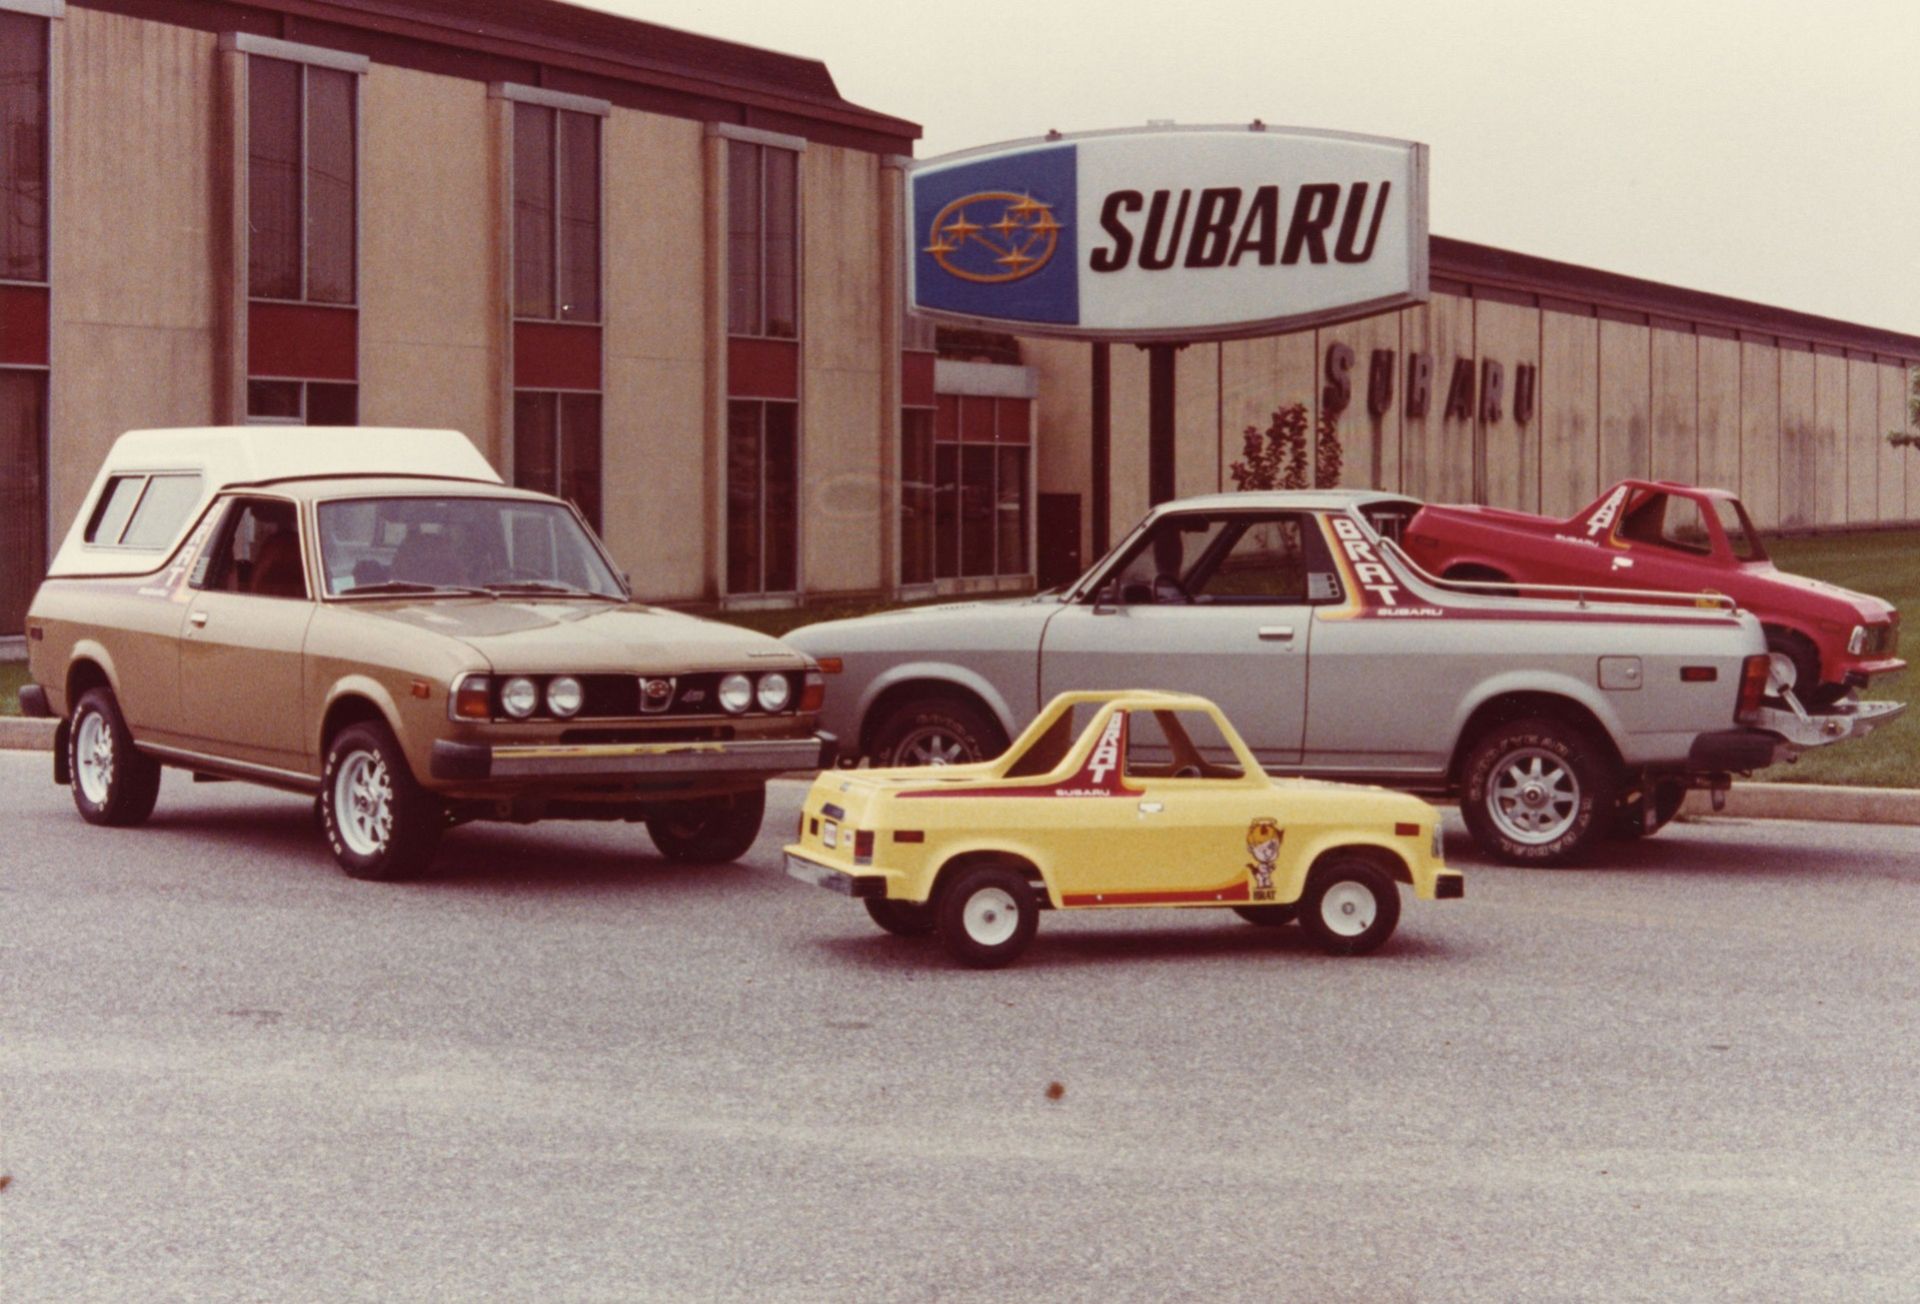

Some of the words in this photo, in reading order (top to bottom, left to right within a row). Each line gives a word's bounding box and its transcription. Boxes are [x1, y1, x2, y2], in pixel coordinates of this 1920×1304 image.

[1089, 181, 1391, 272] SUBARU
[1322, 341, 1536, 425] SUBARU
[1332, 518, 1399, 605] BRAT
[1376, 607, 1443, 616] SUBARU
[1055, 784, 1111, 797] SUBARU
